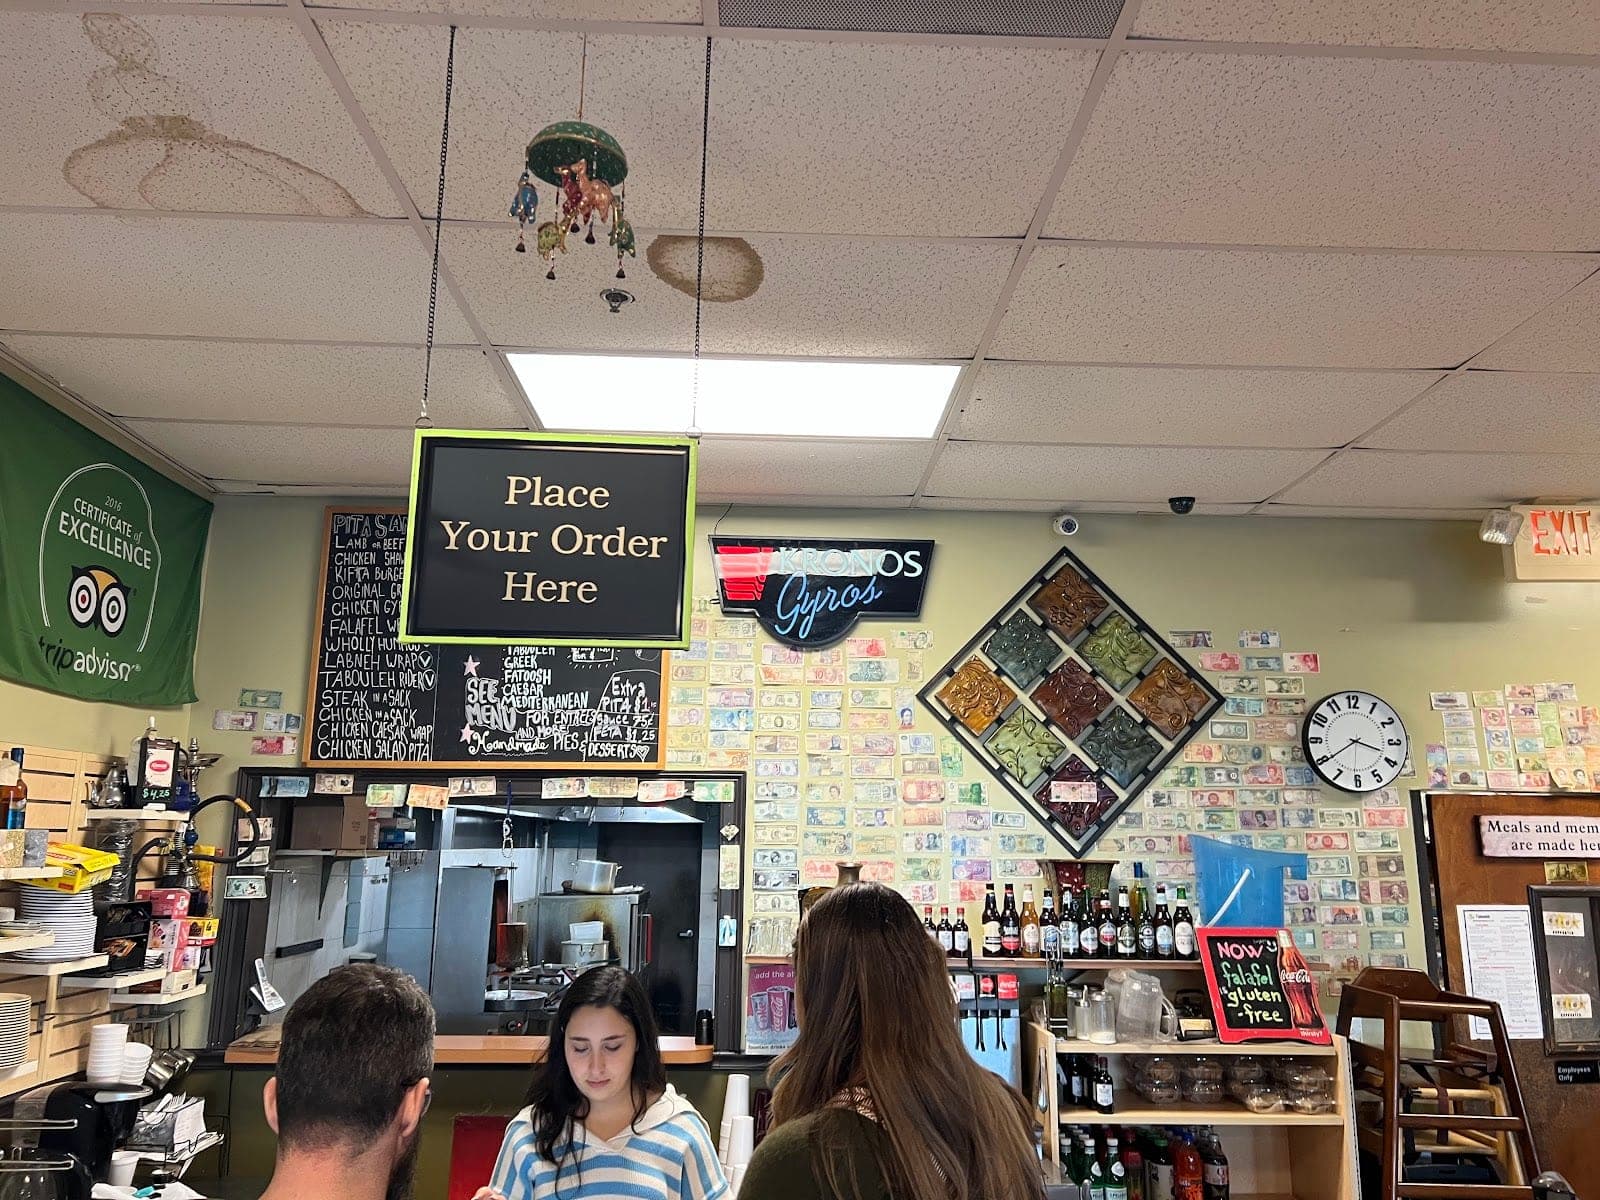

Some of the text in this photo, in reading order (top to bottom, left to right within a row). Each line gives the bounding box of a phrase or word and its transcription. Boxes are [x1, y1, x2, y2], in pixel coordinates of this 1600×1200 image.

[504, 475, 610, 509] Place
[105, 496, 122, 511] 2016
[74, 498, 143, 544] CERTIFICATE of
[334, 514, 372, 537] PITA
[59, 511, 151, 570] EXCELLENCE
[440, 520, 668, 558] Your Order
[1530, 511, 1591, 555] EXIT
[335, 536, 368, 549] LAMB
[383, 537, 405, 550] BEEF
[335, 552, 376, 565] CHICKEN
[779, 547, 923, 578] KRONOS
[333, 583, 385, 599] ORIGINAL
[502, 571, 598, 603] Here
[331, 599, 380, 616] CHICKEN
[775, 571, 883, 638] Gyros
[330, 616, 383, 637] FALAFEL
[325, 652, 380, 670] LABNEH
[386, 653, 417, 669] WRAP
[504, 655, 538, 669] GREEK
[320, 671, 395, 688] TABOULEH
[399, 671, 424, 692] RIDER
[504, 668, 551, 685] FATOOSH
[466, 679, 500, 704] SEE
[502, 682, 544, 697] CAESAR
[612, 676, 646, 698] Extra
[322, 689, 369, 710] STEAK
[388, 689, 411, 707] SACK
[602, 697, 632, 715] PITA
[1327, 698, 1341, 714] 11
[1346, 695, 1359, 709] 12
[465, 702, 517, 731] MENU
[1369, 702, 1378, 715] 1
[319, 708, 372, 722] CHICKEN
[390, 708, 418, 728] SACK
[526, 711, 550, 727] FOR
[1312, 713, 1328, 728] 10
[1380, 717, 1395, 729] 2
[318, 720, 433, 744] CHICKEN CAESAR WRAP
[517, 726, 536, 740] AND
[593, 724, 623, 742] FETA
[1309, 736, 1323, 744] 9
[468, 730, 549, 755] Handmade
[554, 732, 579, 751] PIES
[1387, 738, 1401, 746] 3
[317, 740, 431, 763] CHICKEN SALAD PITA
[588, 742, 637, 760] DESSERTS
[1384, 757, 1398, 768] 4
[1332, 768, 1343, 781] 7
[1353, 774, 1362, 788] 6
[1370, 769, 1383, 784] 5
[143, 788, 170, 800] $4.25
[1488, 820, 1530, 833] Meals
[1535, 821, 1560, 833] and
[1511, 841, 1533, 851] are
[1538, 840, 1575, 851] made
[1216, 941, 1263, 960] NOW
[755, 971, 770, 979] add
[772, 970, 785, 978] the
[1227, 986, 1282, 1008] gluten
[1557, 1066, 1591, 1075] Employees
[1558, 1074, 1573, 1082] Only
